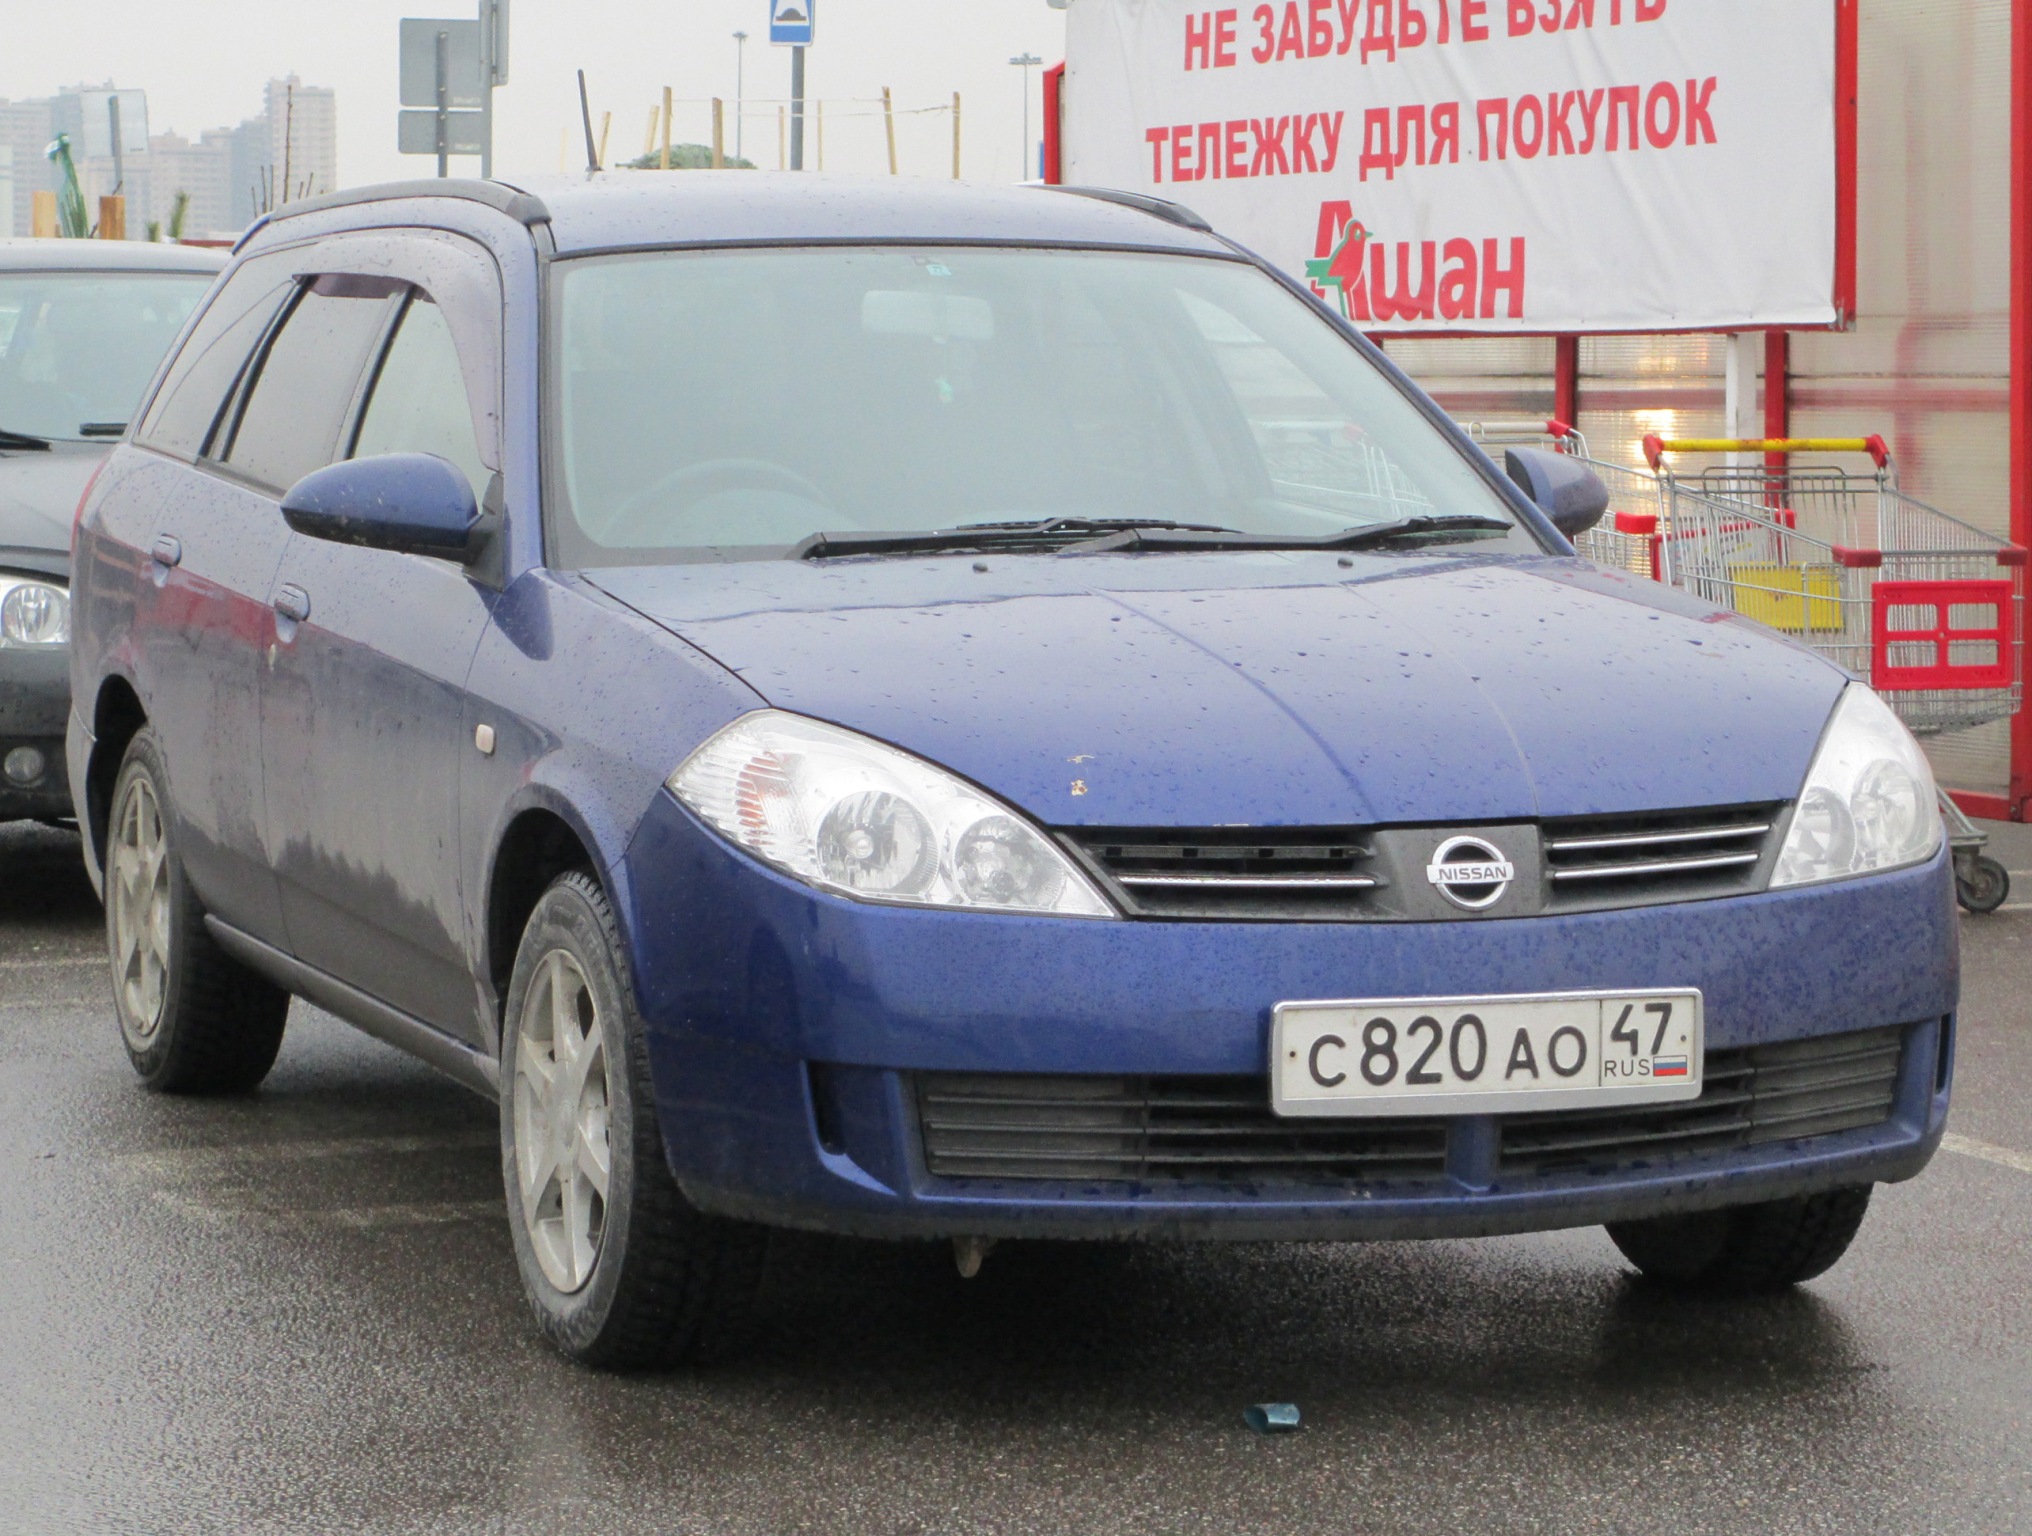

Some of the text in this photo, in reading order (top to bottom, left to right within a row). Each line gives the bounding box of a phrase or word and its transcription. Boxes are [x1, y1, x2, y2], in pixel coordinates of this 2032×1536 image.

[1184, 9, 1237, 71] НЕ
[1251, 0, 1489, 65] ЗАБУДЬТЕ
[1145, 76, 1717, 183] ТЕЛЕЖКУ ДЛЯ ПОКУПОК
[1309, 200, 1525, 322] Ашан
[1438, 866, 1507, 881] NISSAN
[1611, 1002, 1673, 1056] 47
[1604, 1058, 1651, 1078] RUS
